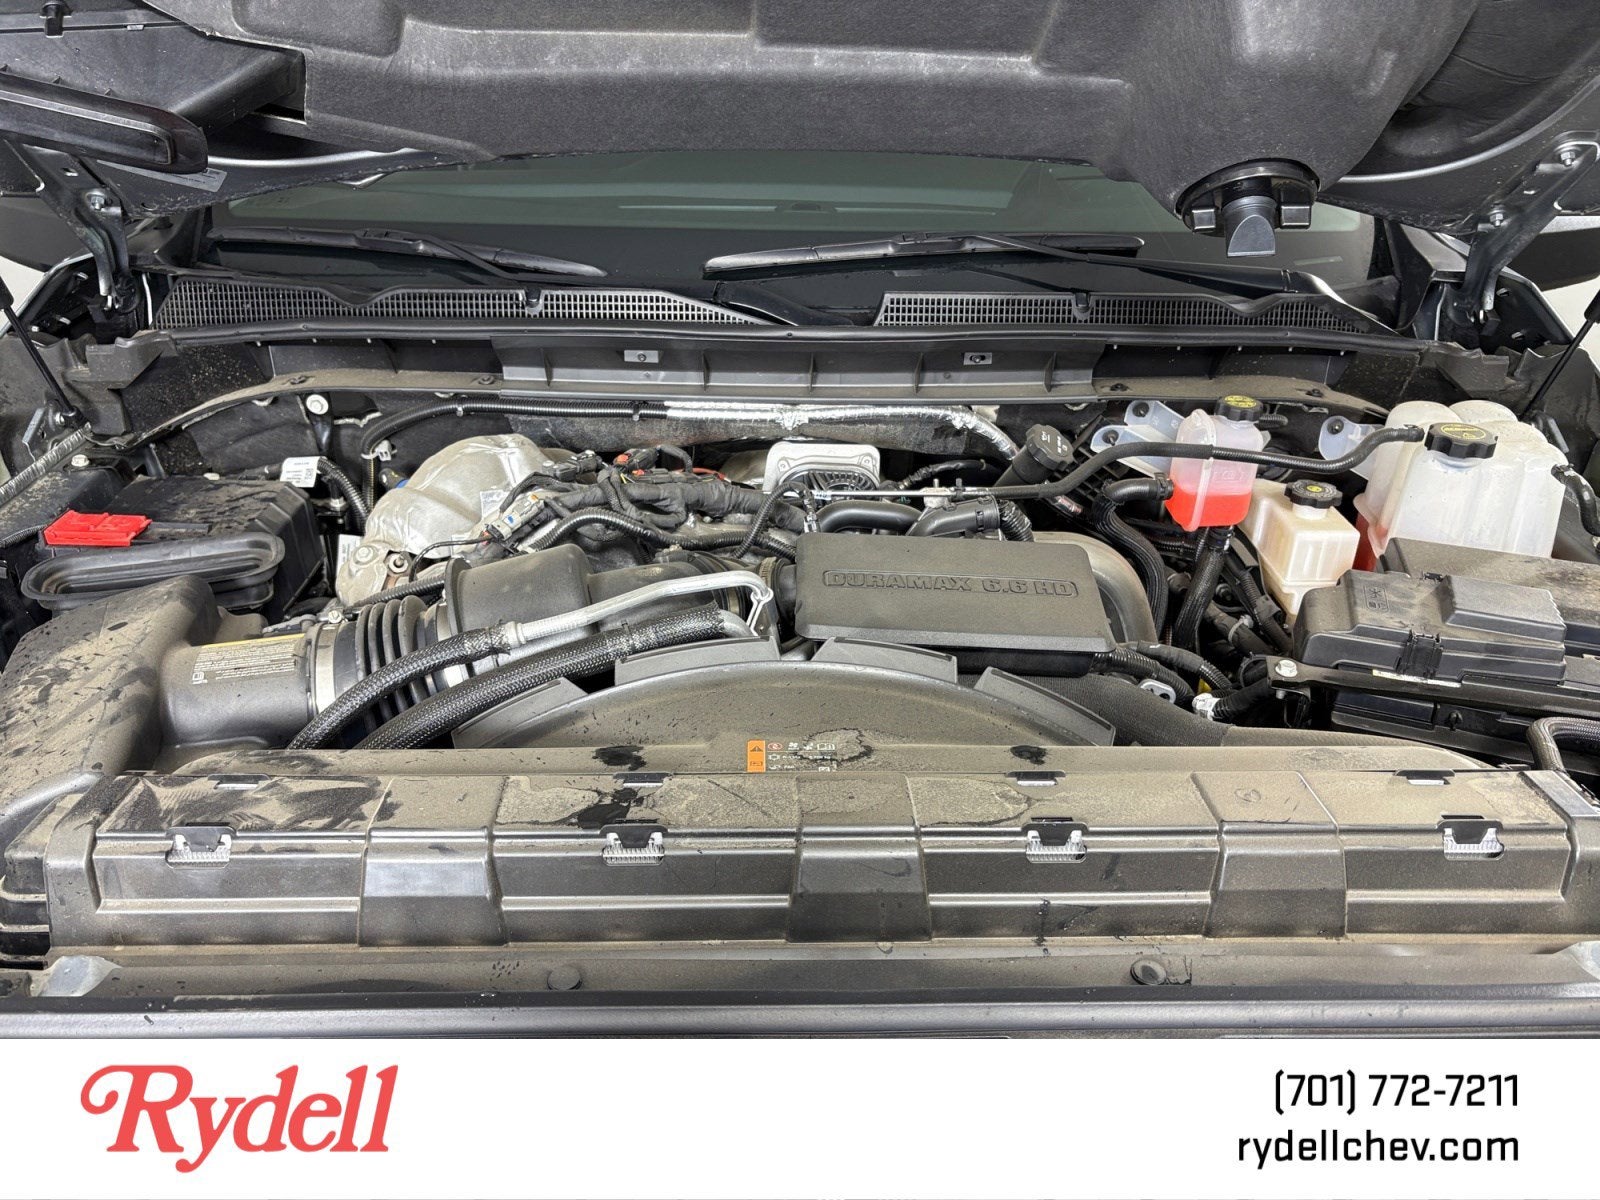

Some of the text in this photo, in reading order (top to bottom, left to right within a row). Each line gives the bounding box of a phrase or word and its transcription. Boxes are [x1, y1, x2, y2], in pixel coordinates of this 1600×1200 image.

[826, 571, 1075, 597] DURAMAX 6.6 HD
